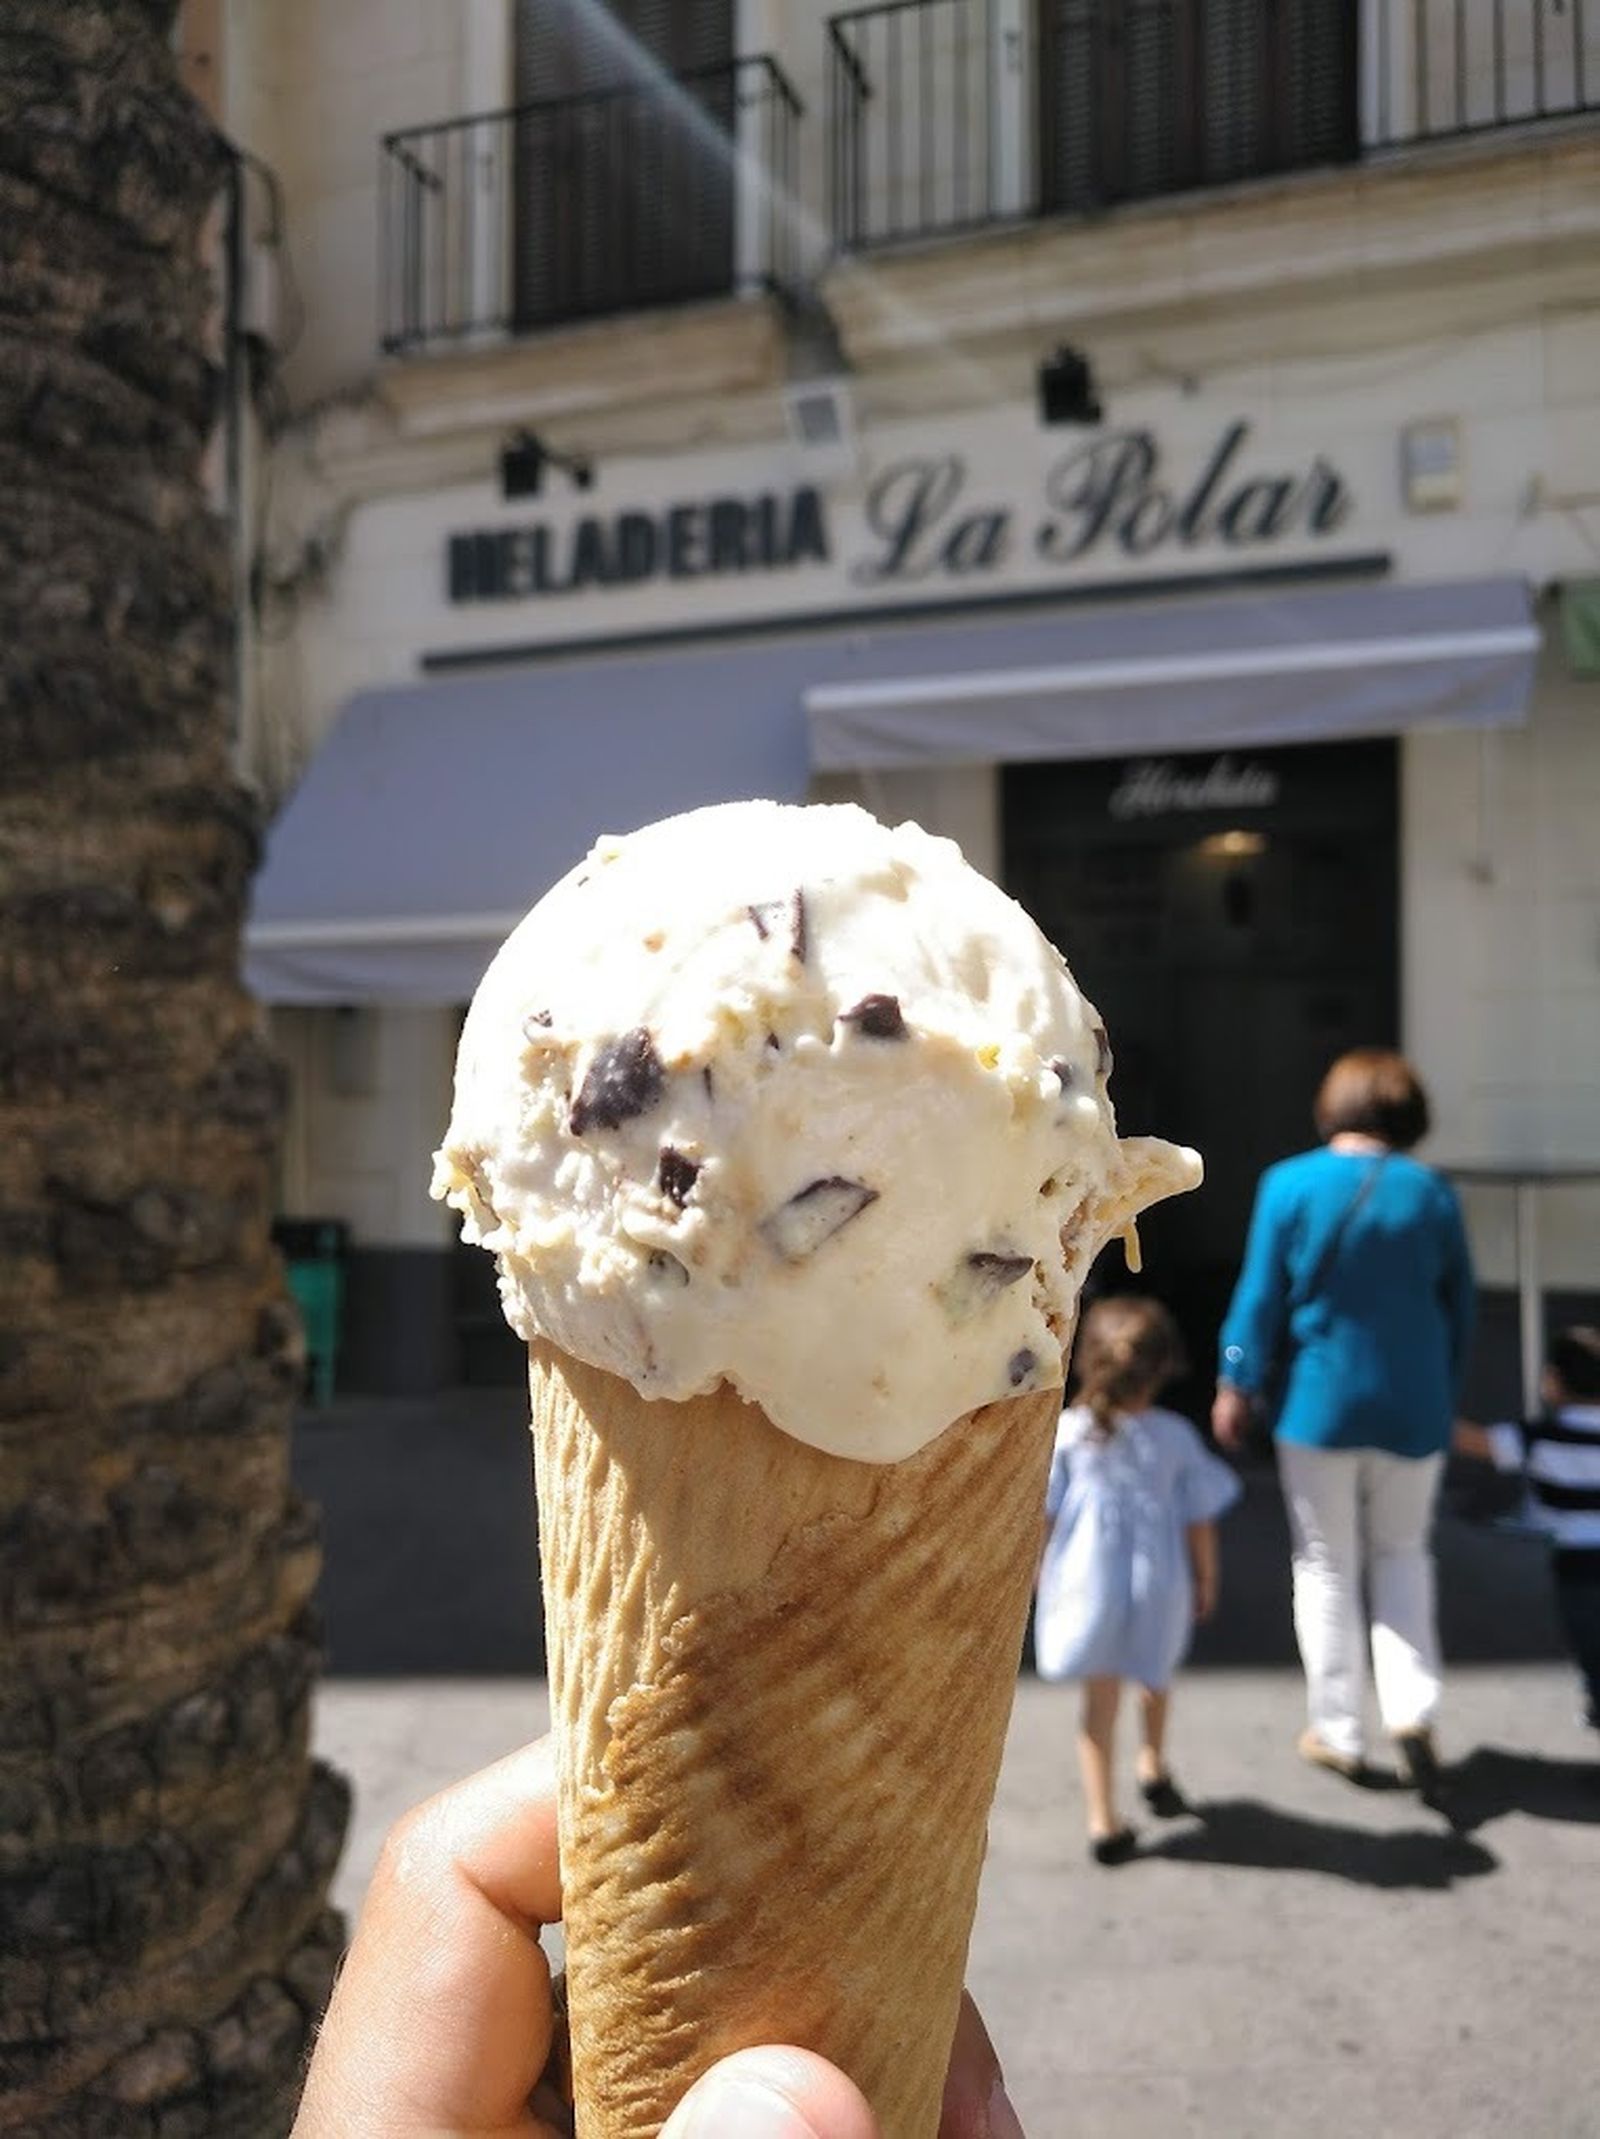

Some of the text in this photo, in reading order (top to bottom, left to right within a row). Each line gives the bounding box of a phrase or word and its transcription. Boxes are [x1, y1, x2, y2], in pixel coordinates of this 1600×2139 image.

[449, 415, 1351, 602] HELADERIA La Polar
